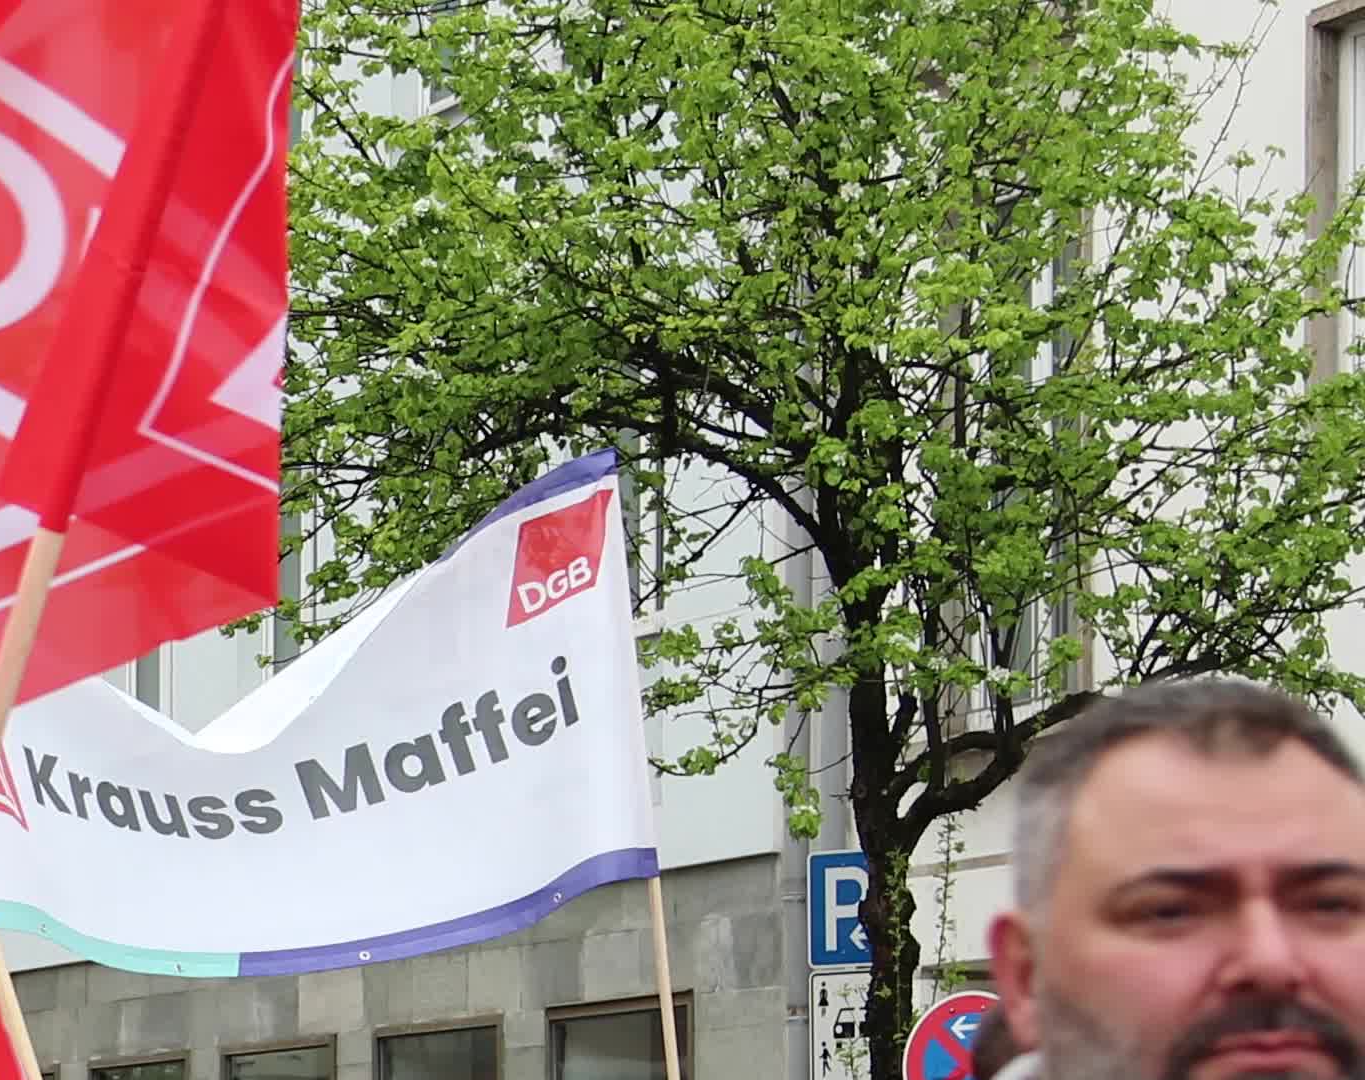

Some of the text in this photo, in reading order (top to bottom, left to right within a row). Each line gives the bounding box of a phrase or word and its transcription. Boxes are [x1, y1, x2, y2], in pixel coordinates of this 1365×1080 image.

[517, 556, 592, 613] DGB
[22, 745, 284, 840] Krauss
[294, 655, 581, 820] Maffei
[824, 866, 869, 951] P
